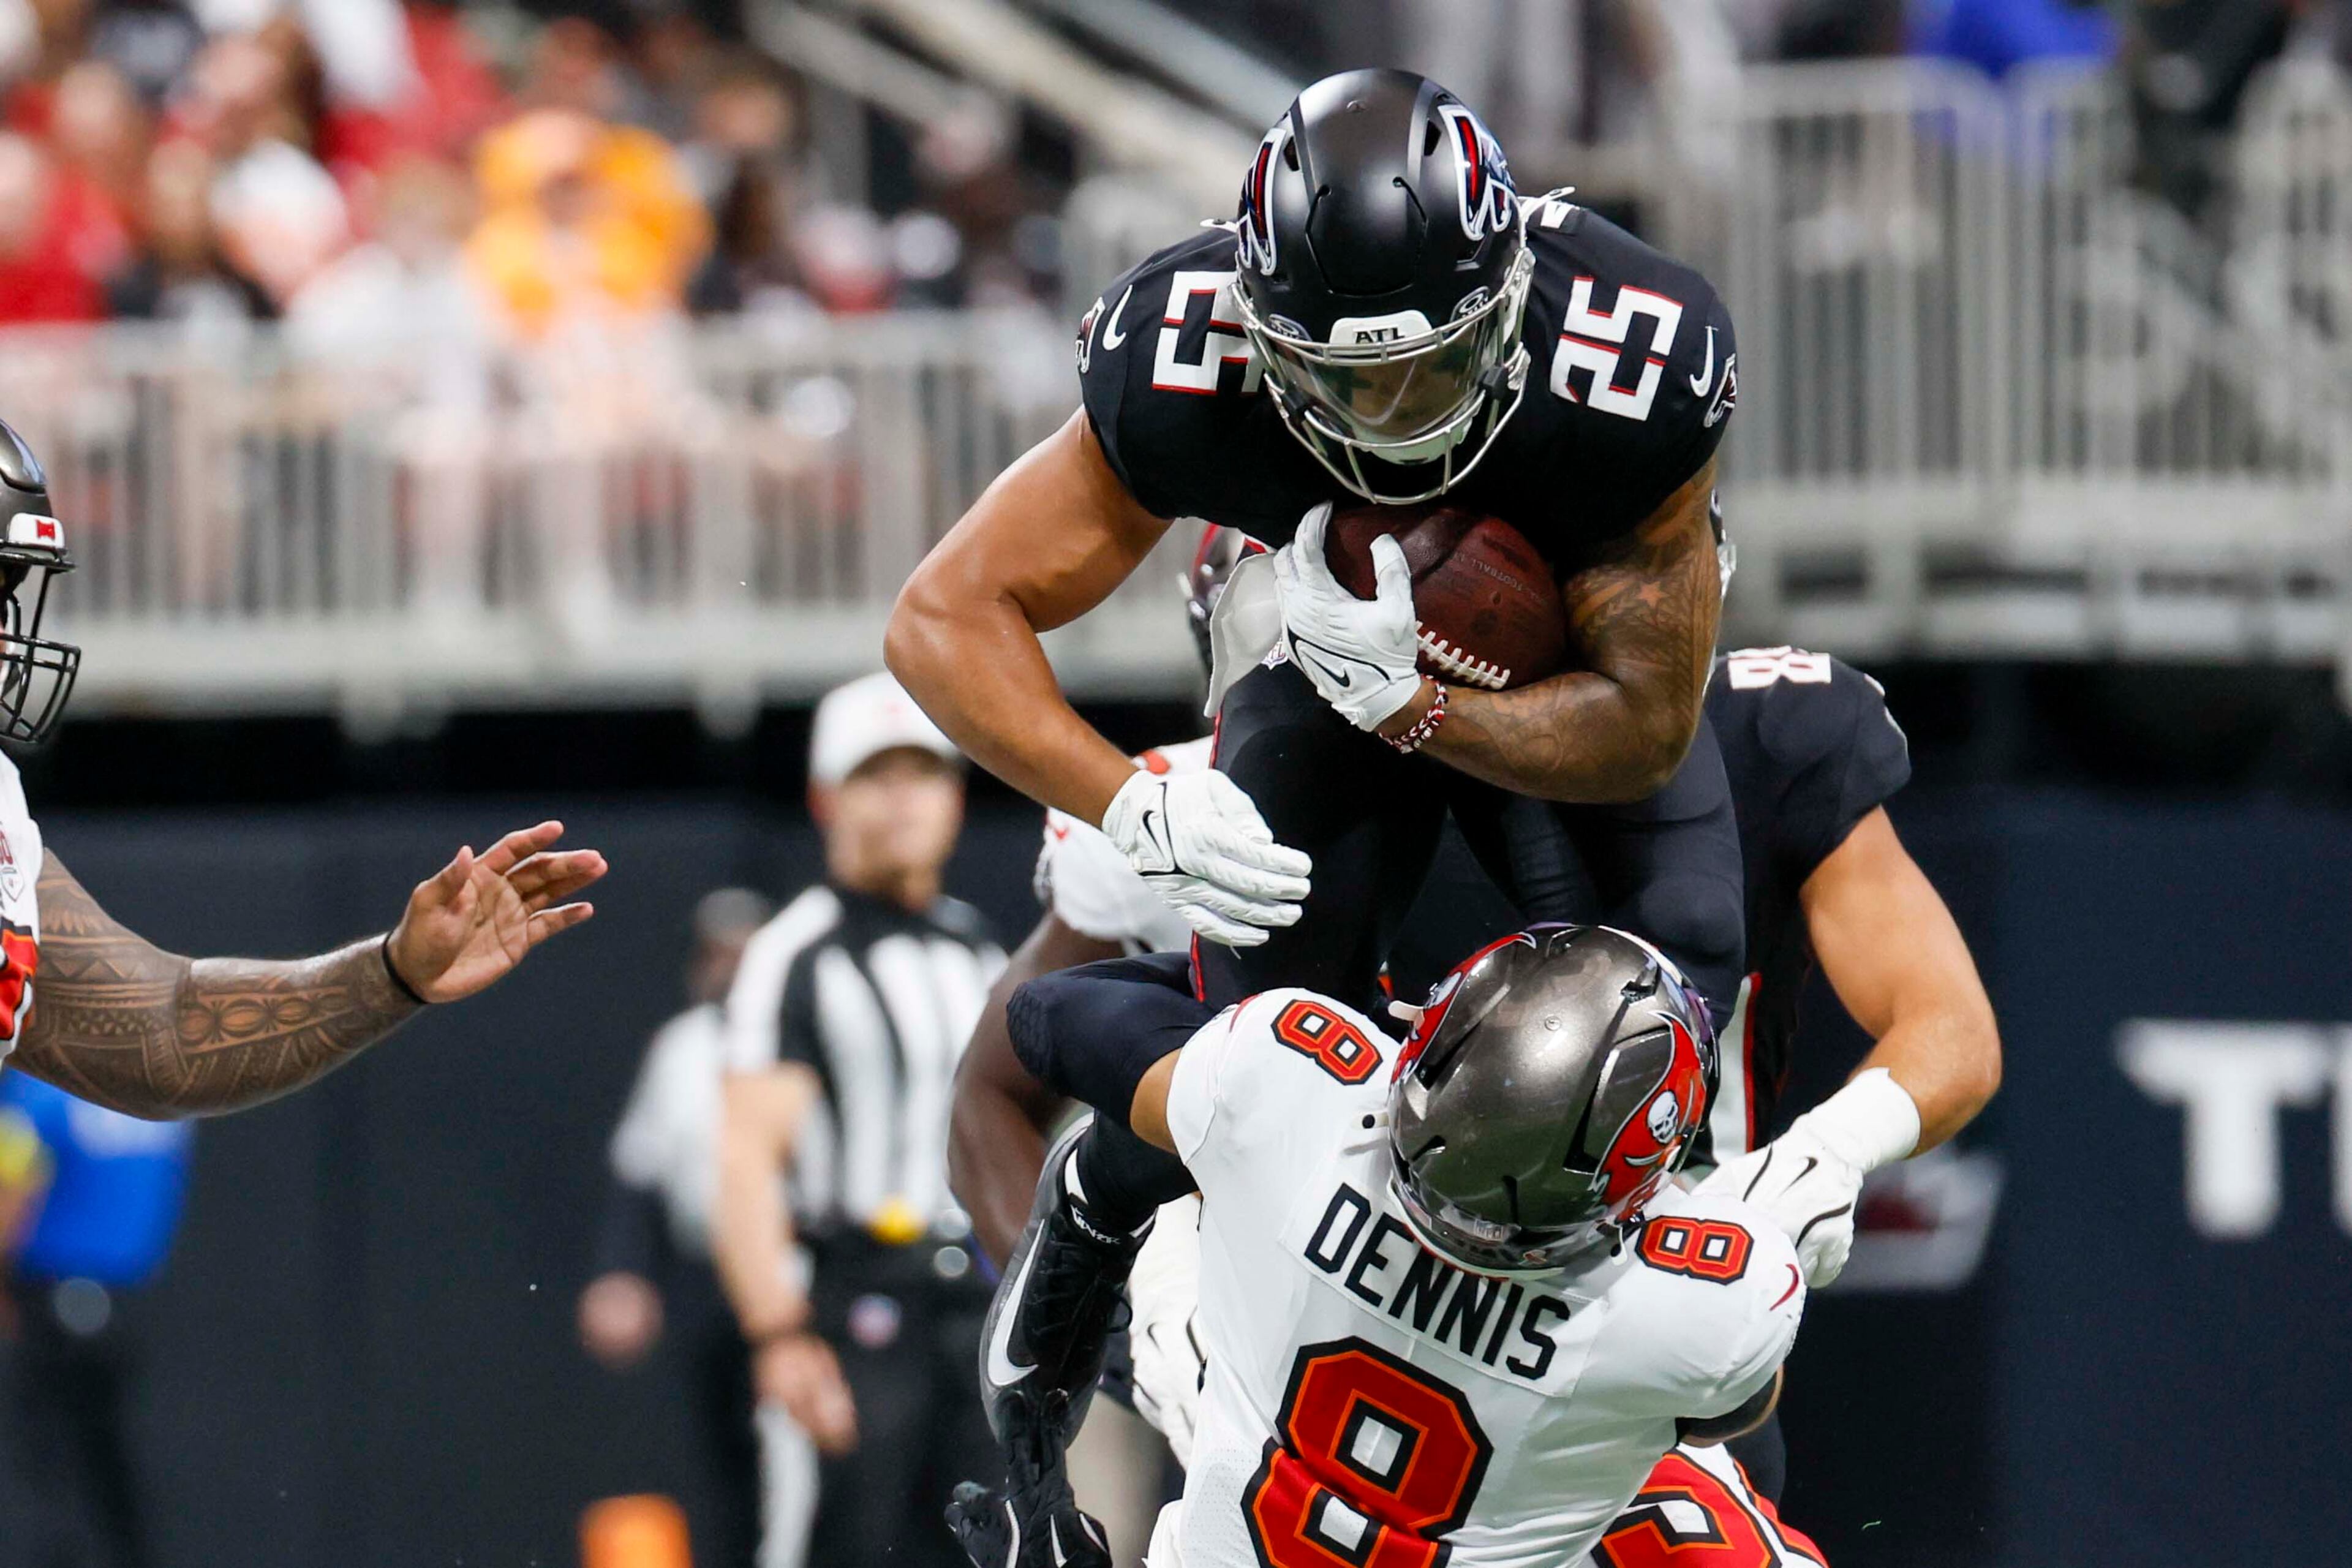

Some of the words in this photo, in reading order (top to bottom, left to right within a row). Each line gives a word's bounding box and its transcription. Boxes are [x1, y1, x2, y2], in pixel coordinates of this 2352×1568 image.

[1354, 328, 1406, 345] ATL
[1550, 275, 1683, 421] 25
[1272, 1000, 1384, 1085] 8
[2115, 1019, 2352, 1238] T
[1303, 1182, 1570, 1381] DENNIS
[1634, 1215, 1755, 1285] 8
[1241, 1335, 1494, 1568] 8
